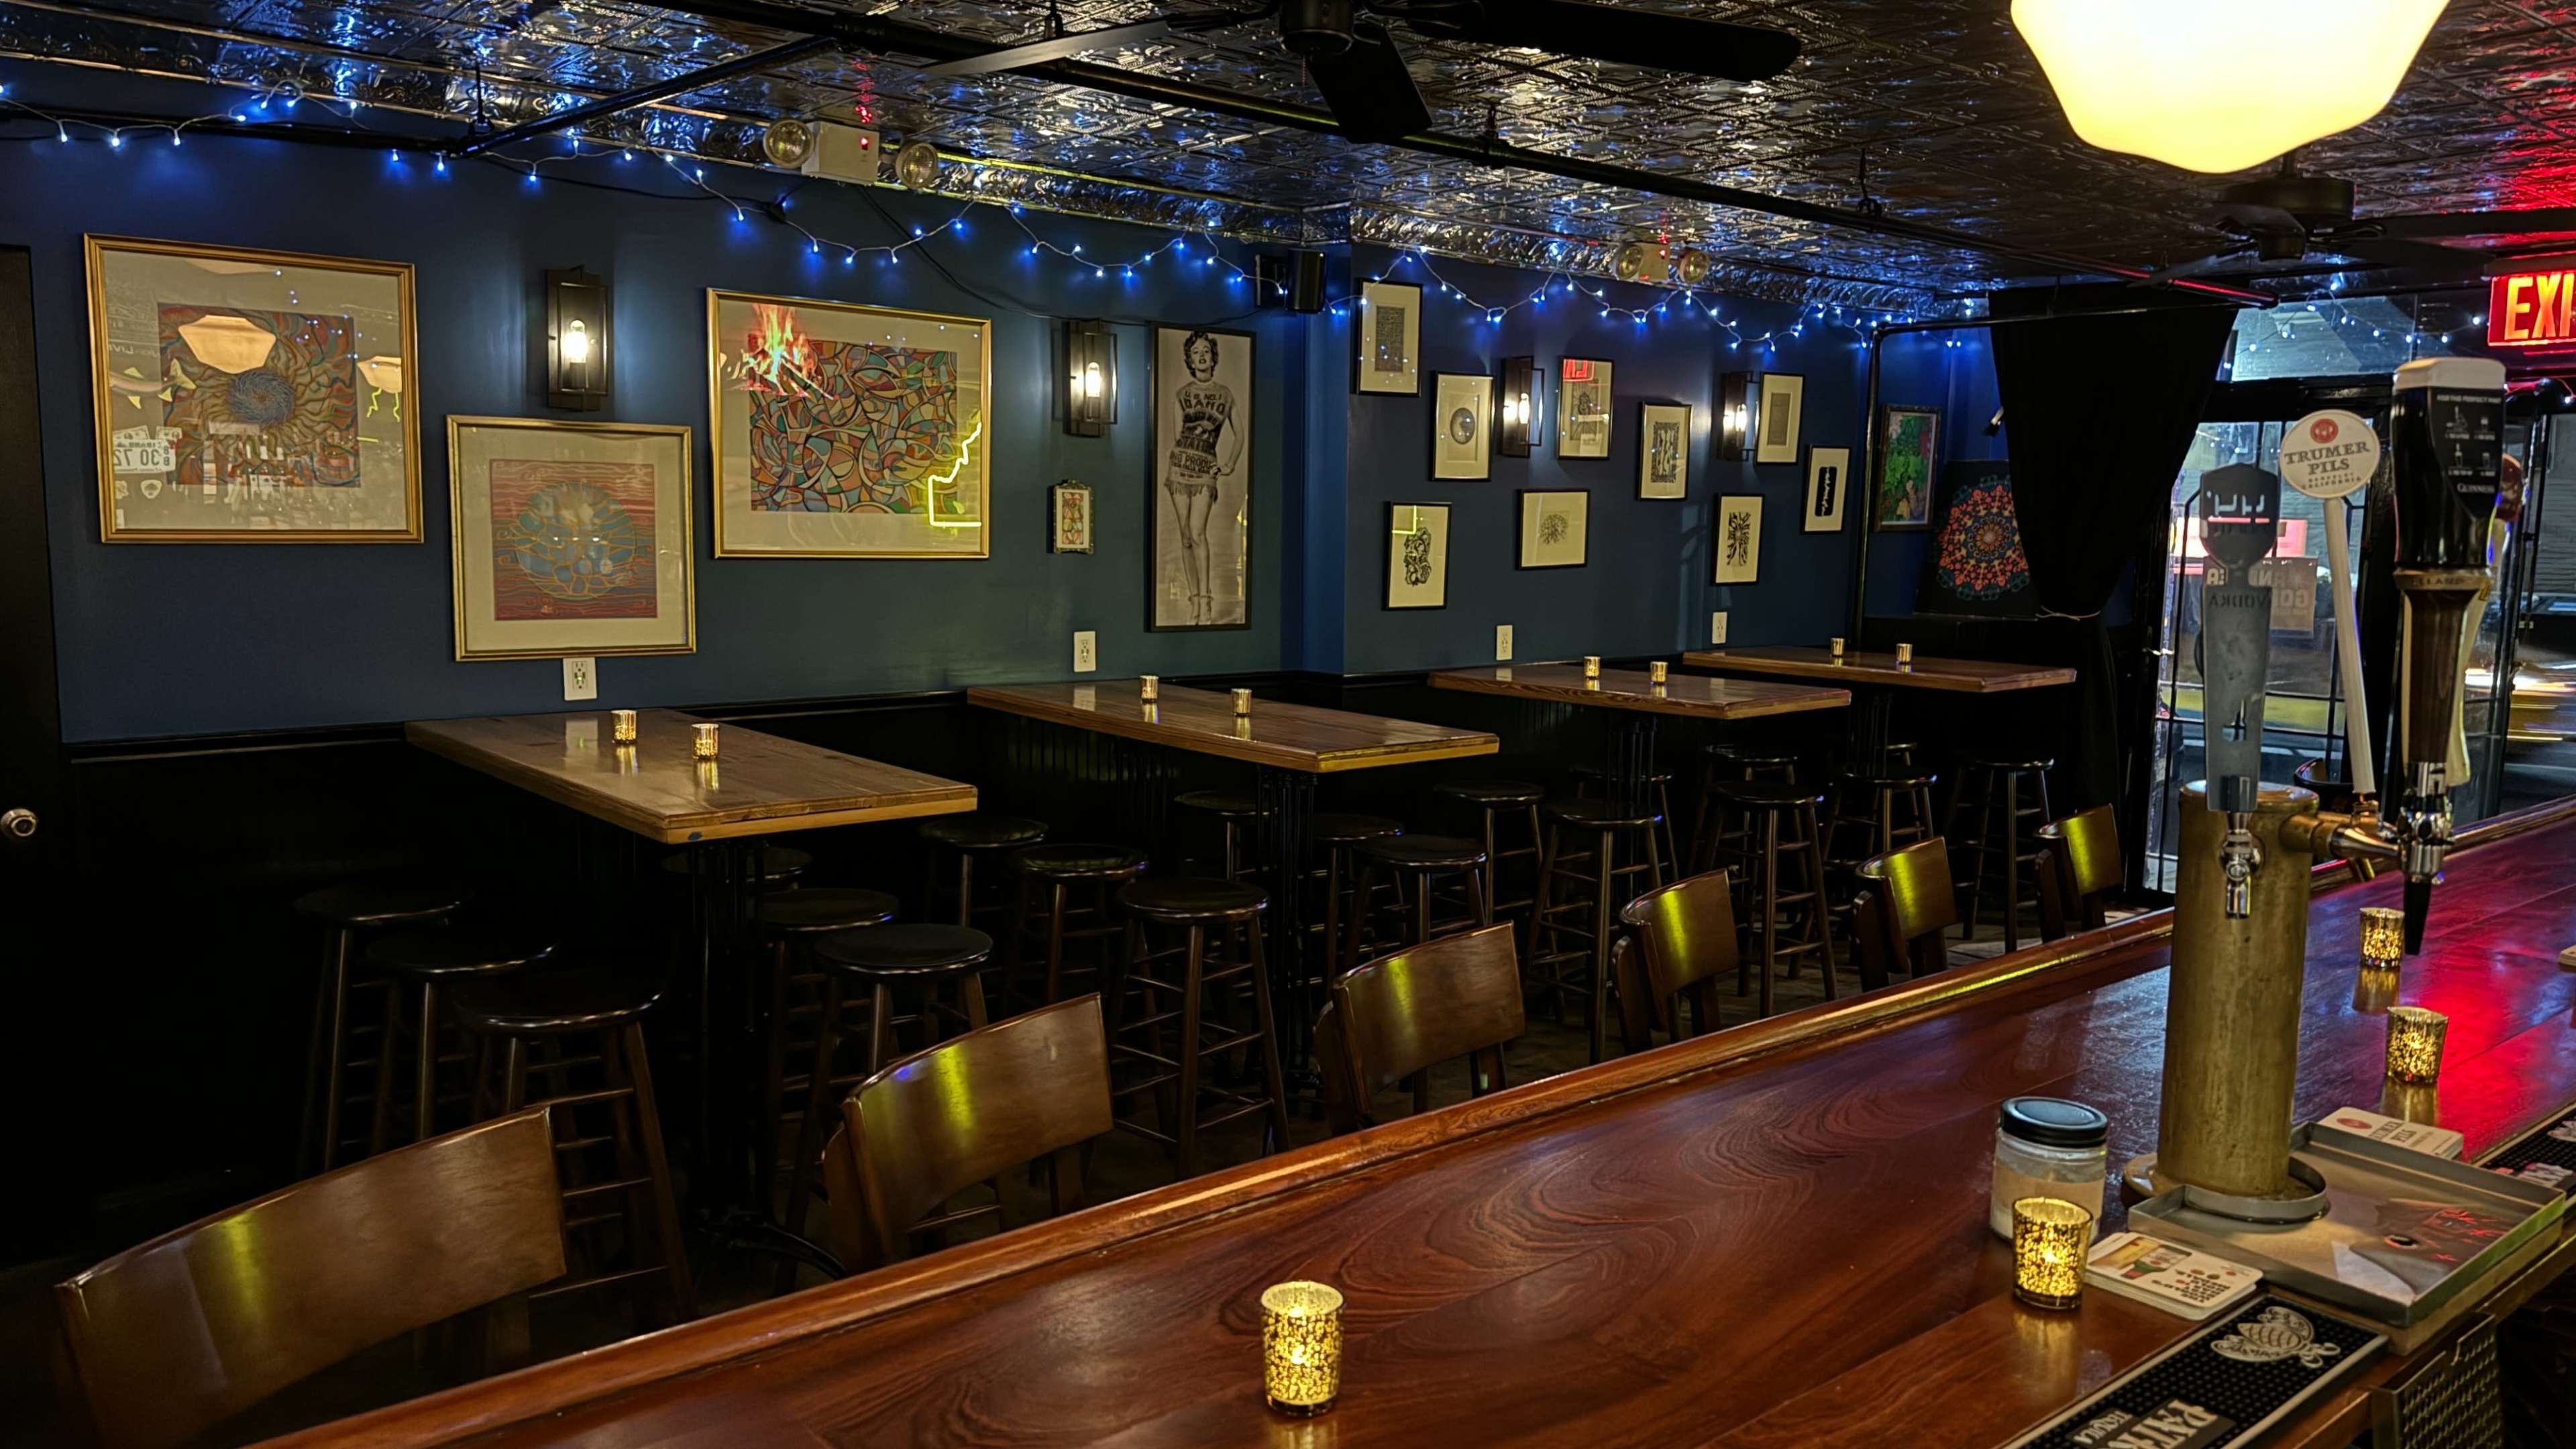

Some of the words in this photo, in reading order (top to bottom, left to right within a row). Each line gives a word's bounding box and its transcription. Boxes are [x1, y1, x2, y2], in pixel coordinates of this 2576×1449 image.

[2504, 273, 2575, 340] EXI
[2284, 441, 2371, 465] TRUMER
[2308, 458, 2350, 476] PILS
[2074, 1410, 2133, 1444] TEQUILA
[2106, 1399, 2218, 1449] PATR
